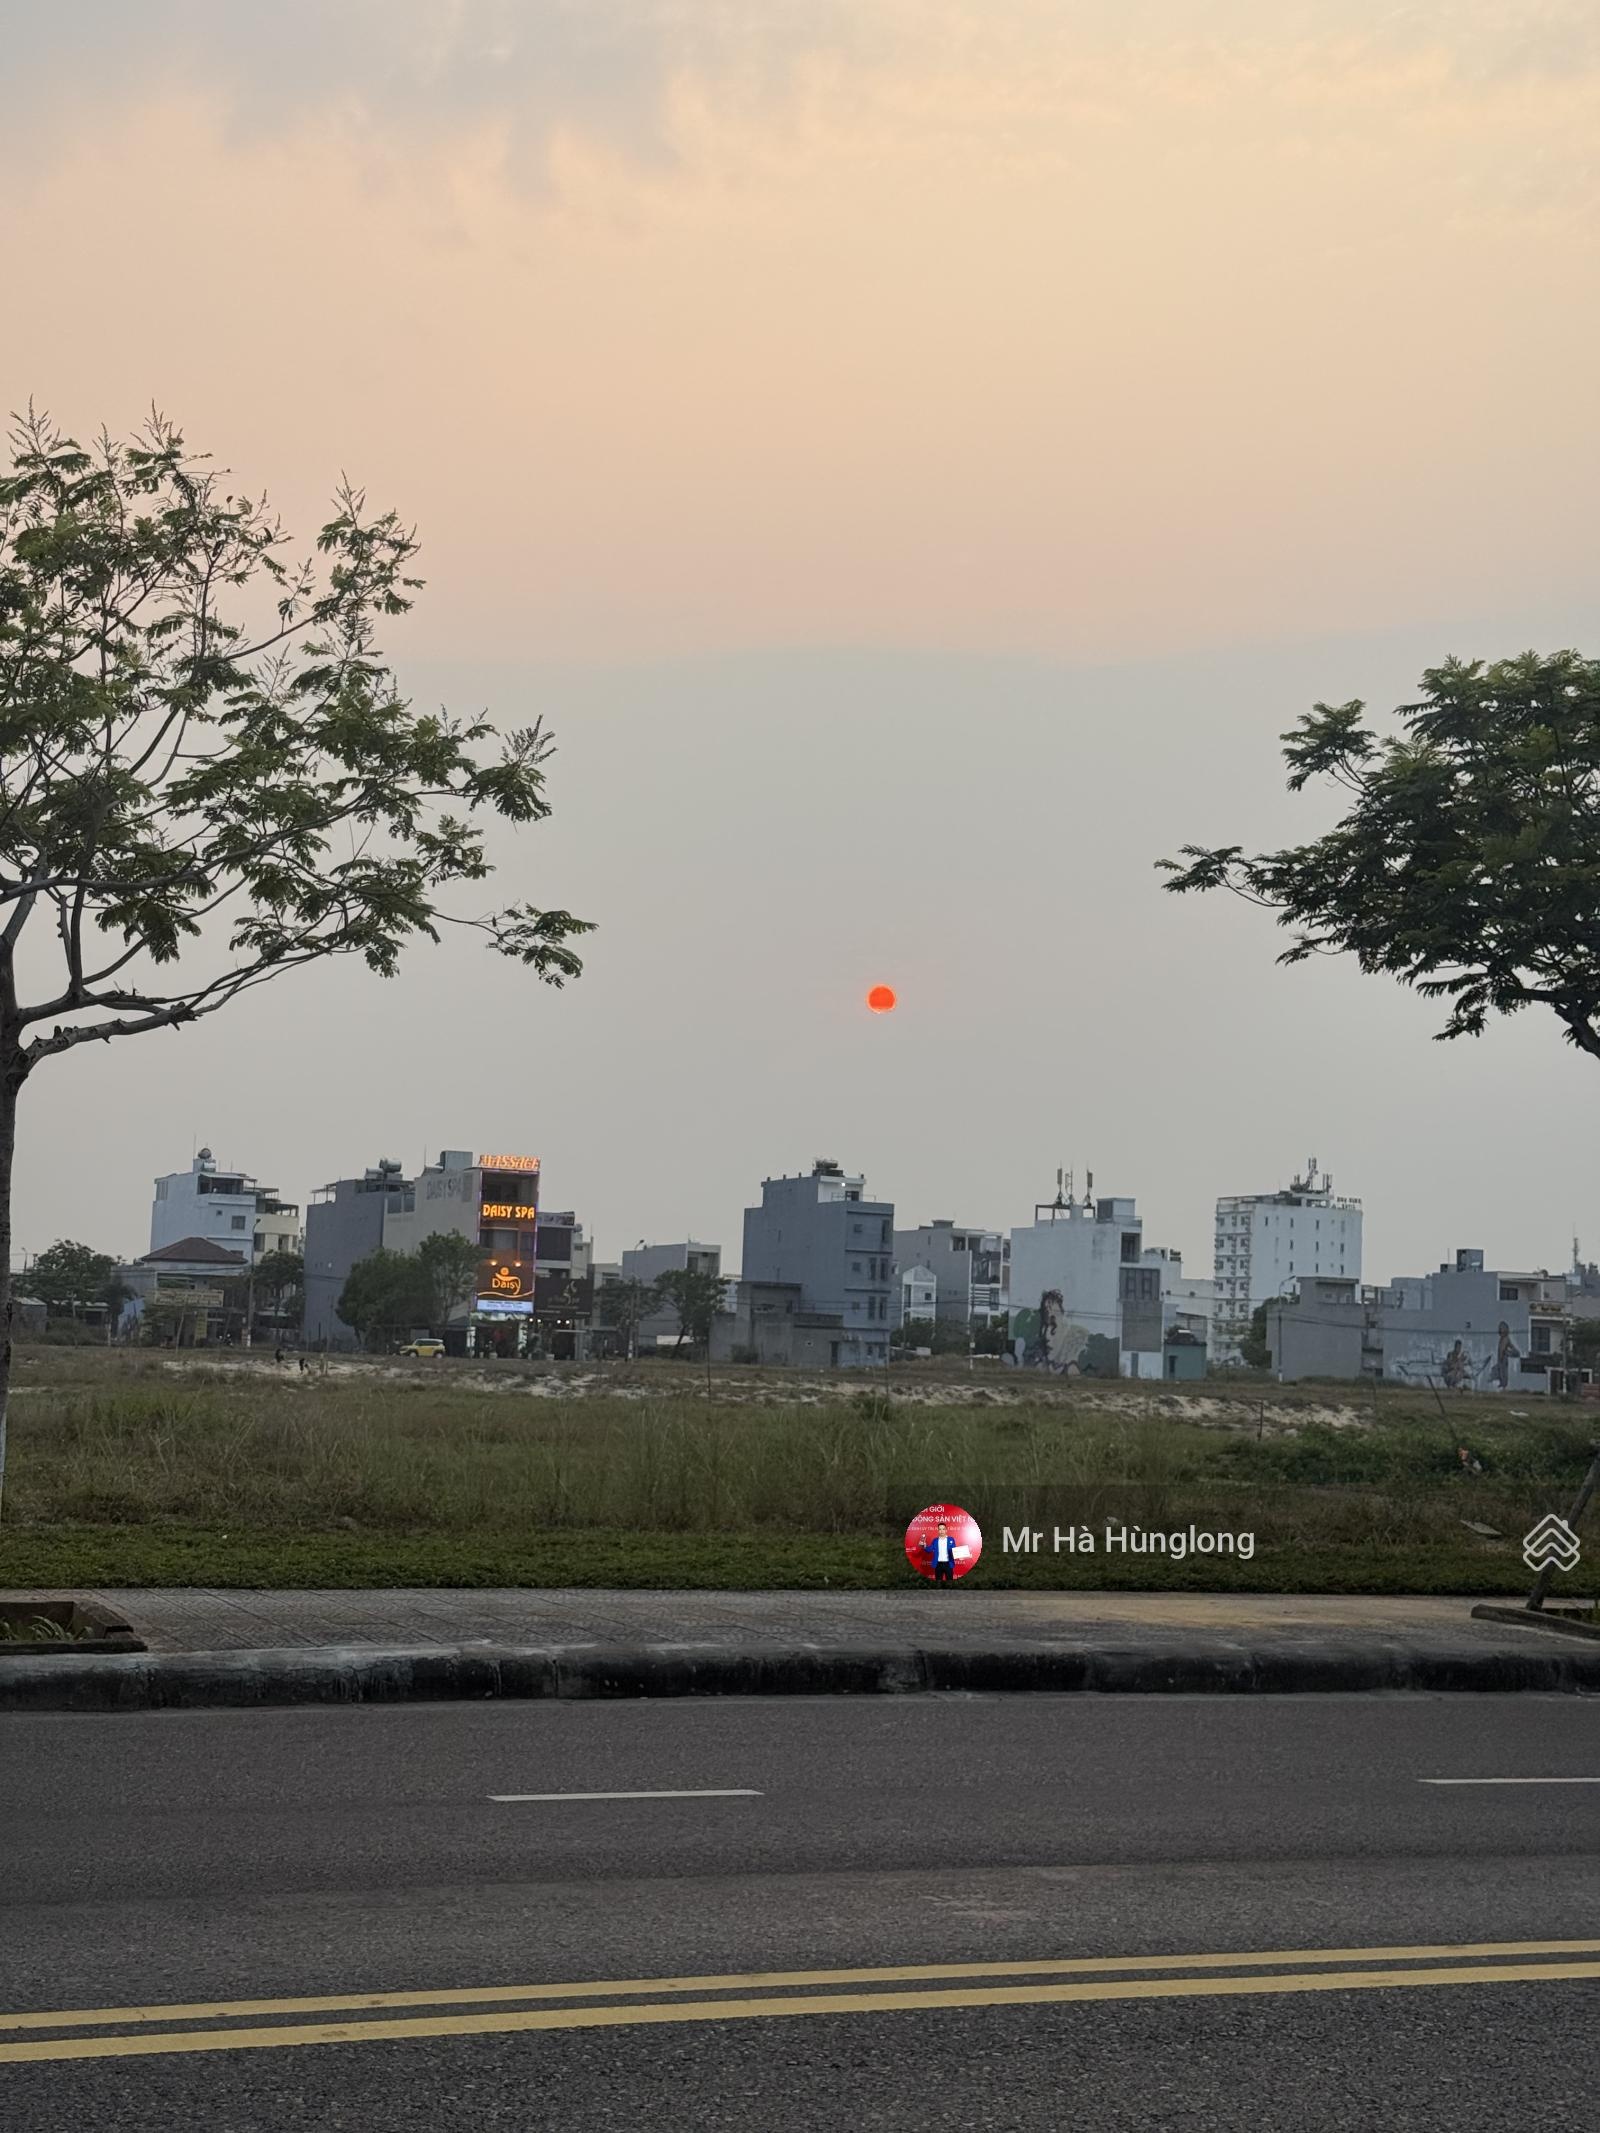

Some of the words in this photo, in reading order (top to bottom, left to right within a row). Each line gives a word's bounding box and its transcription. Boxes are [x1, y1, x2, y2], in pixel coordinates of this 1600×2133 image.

[480, 1155, 541, 1169] MASSAGE
[482, 1204, 513, 1218] DAISY
[515, 1206, 535, 1219] SPA
[491, 1277, 521, 1295] Daisy
